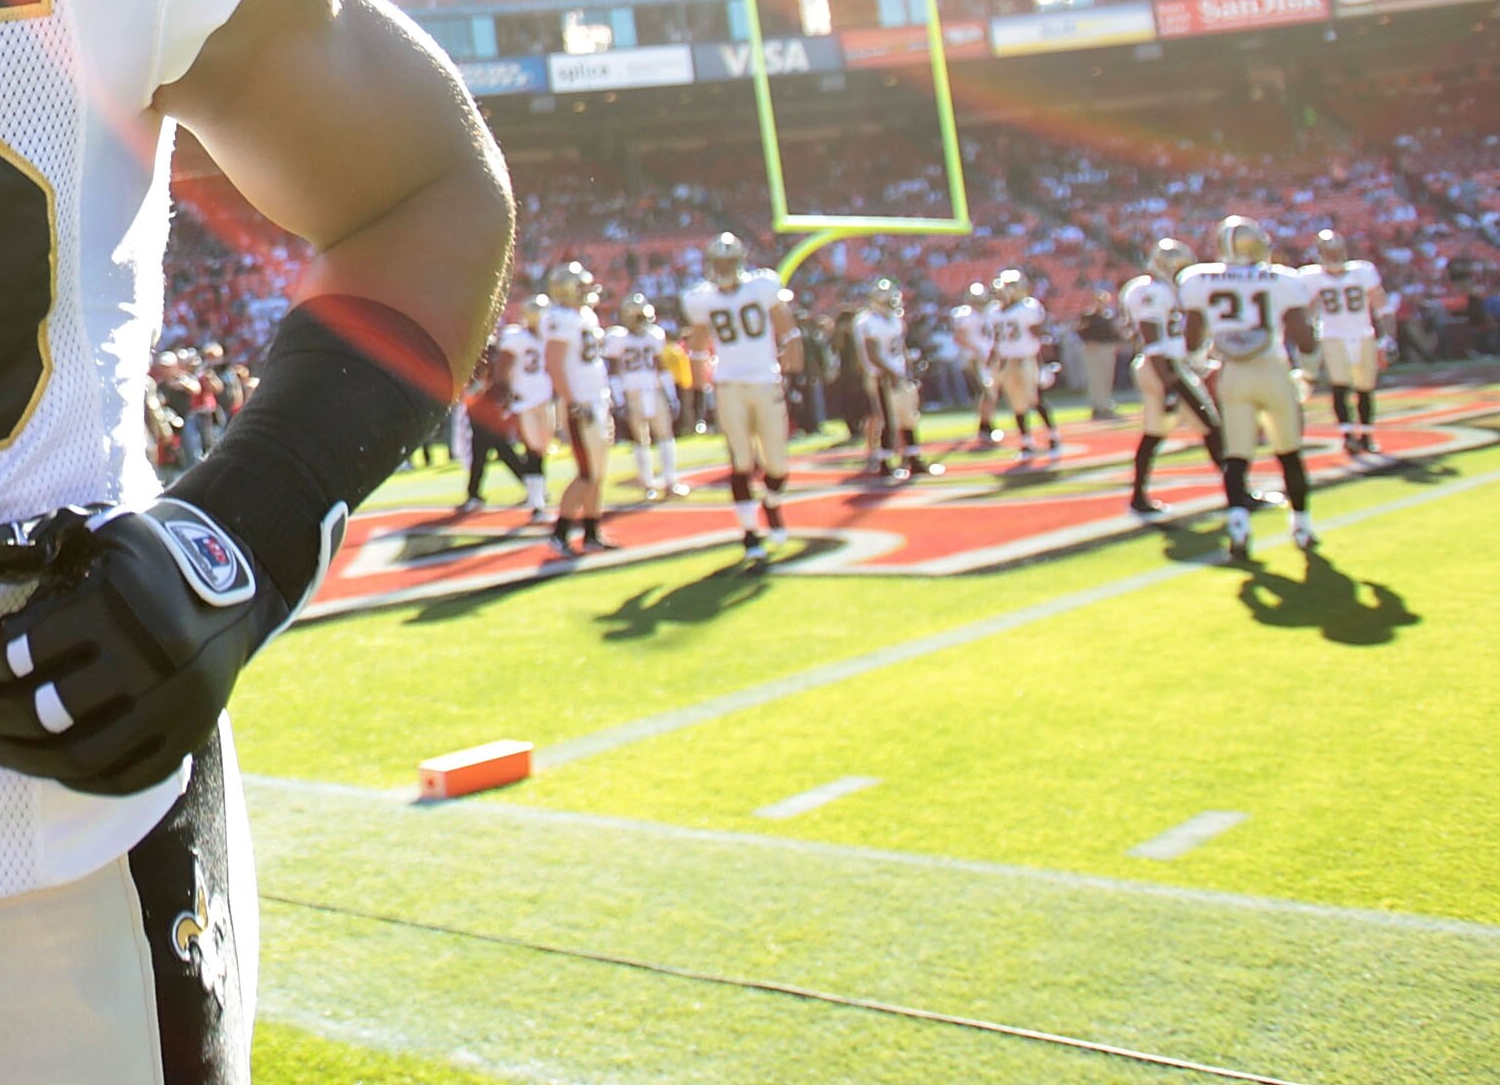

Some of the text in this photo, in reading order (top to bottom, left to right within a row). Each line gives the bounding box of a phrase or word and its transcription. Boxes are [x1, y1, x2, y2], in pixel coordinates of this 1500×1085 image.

[719, 38, 811, 77] VSA
[1320, 286, 1364, 313] 88
[710, 303, 765, 343] 80
